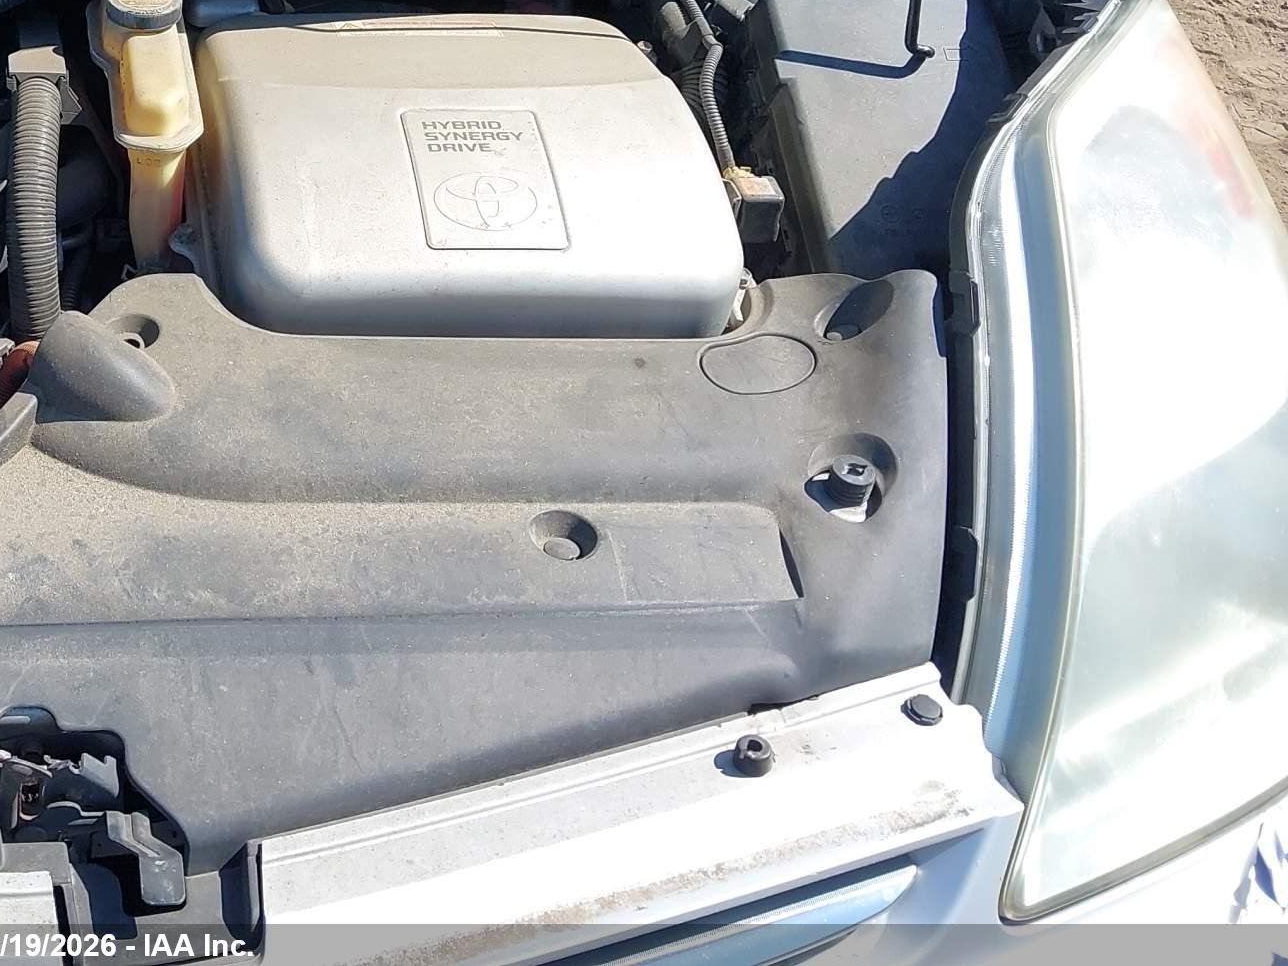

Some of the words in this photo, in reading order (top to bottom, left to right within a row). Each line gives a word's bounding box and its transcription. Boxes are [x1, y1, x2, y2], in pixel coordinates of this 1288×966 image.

[421, 120, 502, 130] HYBRID
[423, 131, 524, 141] SYNERGY
[427, 142, 493, 153] DRIVE
